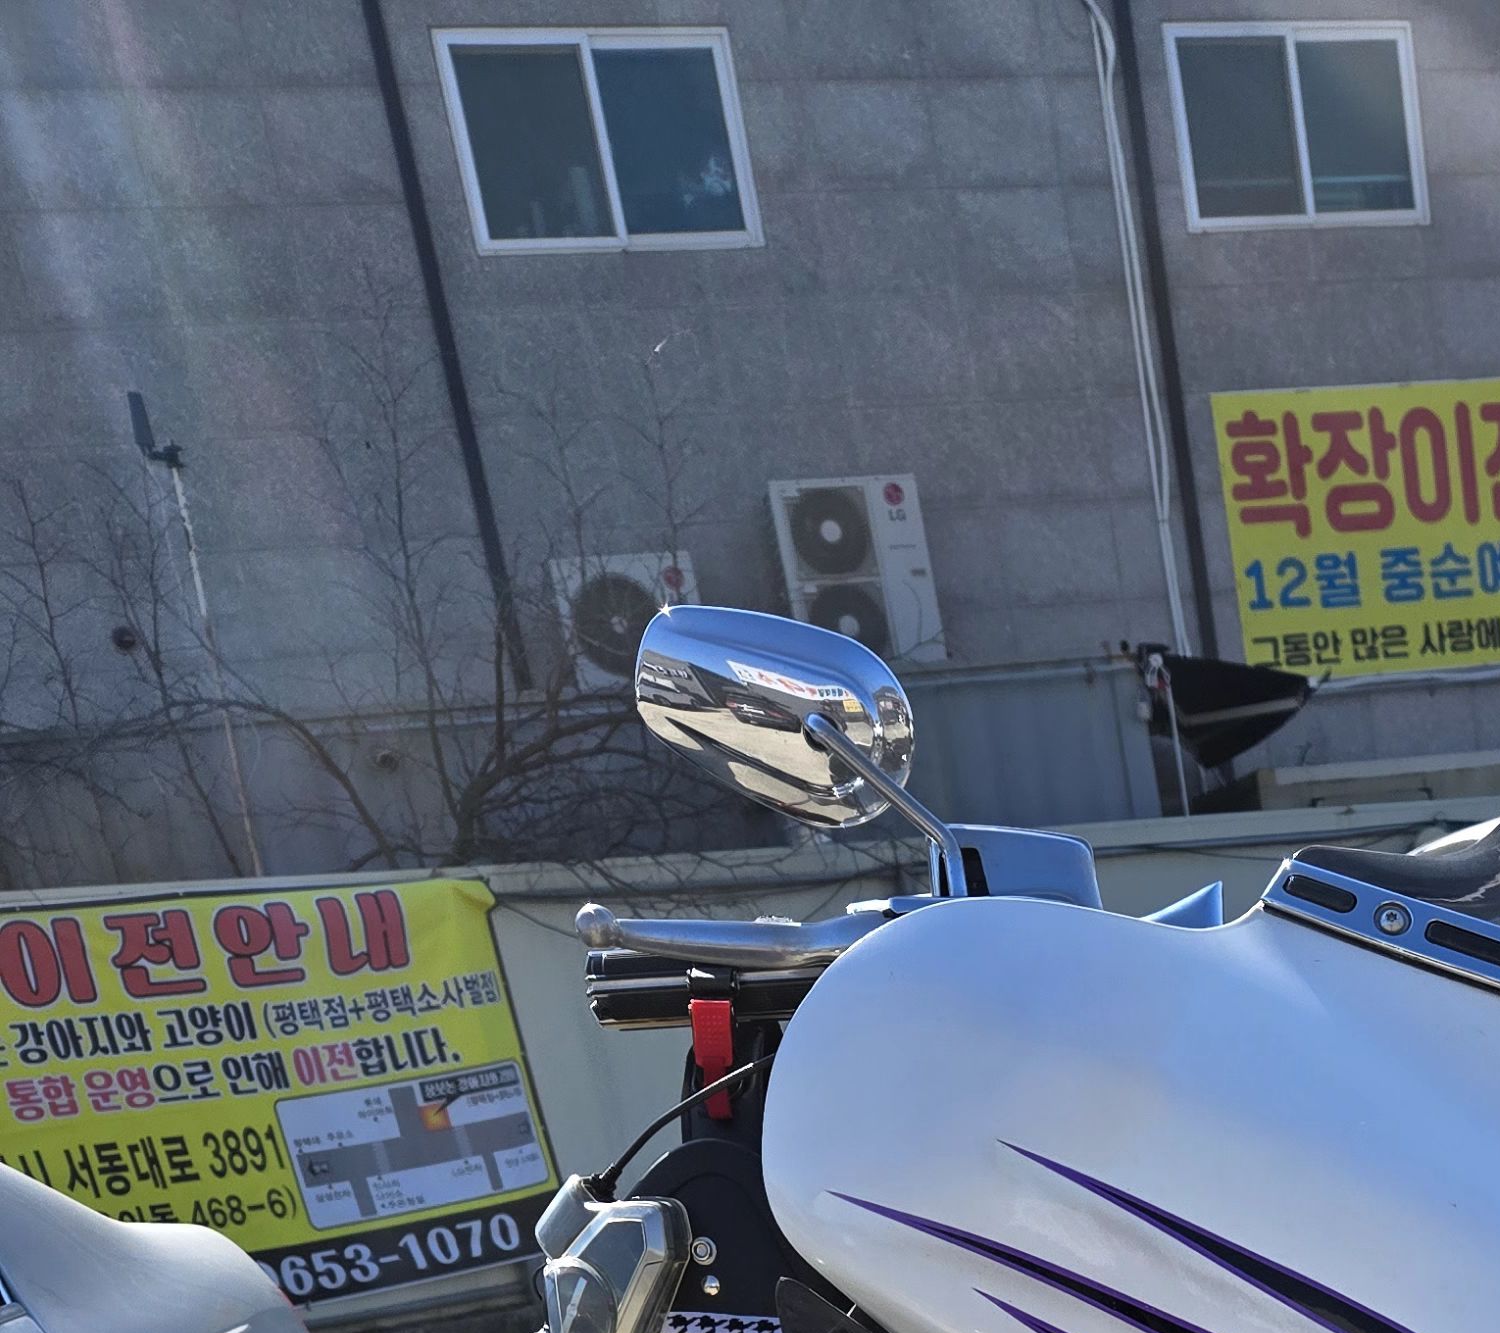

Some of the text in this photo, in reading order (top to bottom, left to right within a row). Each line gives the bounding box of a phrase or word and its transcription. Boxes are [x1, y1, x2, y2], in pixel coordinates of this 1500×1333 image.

[1244, 550, 1362, 611] 12월
[1251, 630, 1341, 668] 그동안
[1350, 624, 1409, 662] 많은
[9, 1012, 152, 1065] 강아지와
[156, 1001, 258, 1049] 고양이
[5, 1027, 462, 1122] 통합 운영으로 인해 이전합니다.
[64, 1135, 201, 1199] 서동대로
[202, 1123, 285, 1179] 3891
[191, 1184, 298, 1229] 468-6)
[258, 1213, 521, 1297] 653-1070
